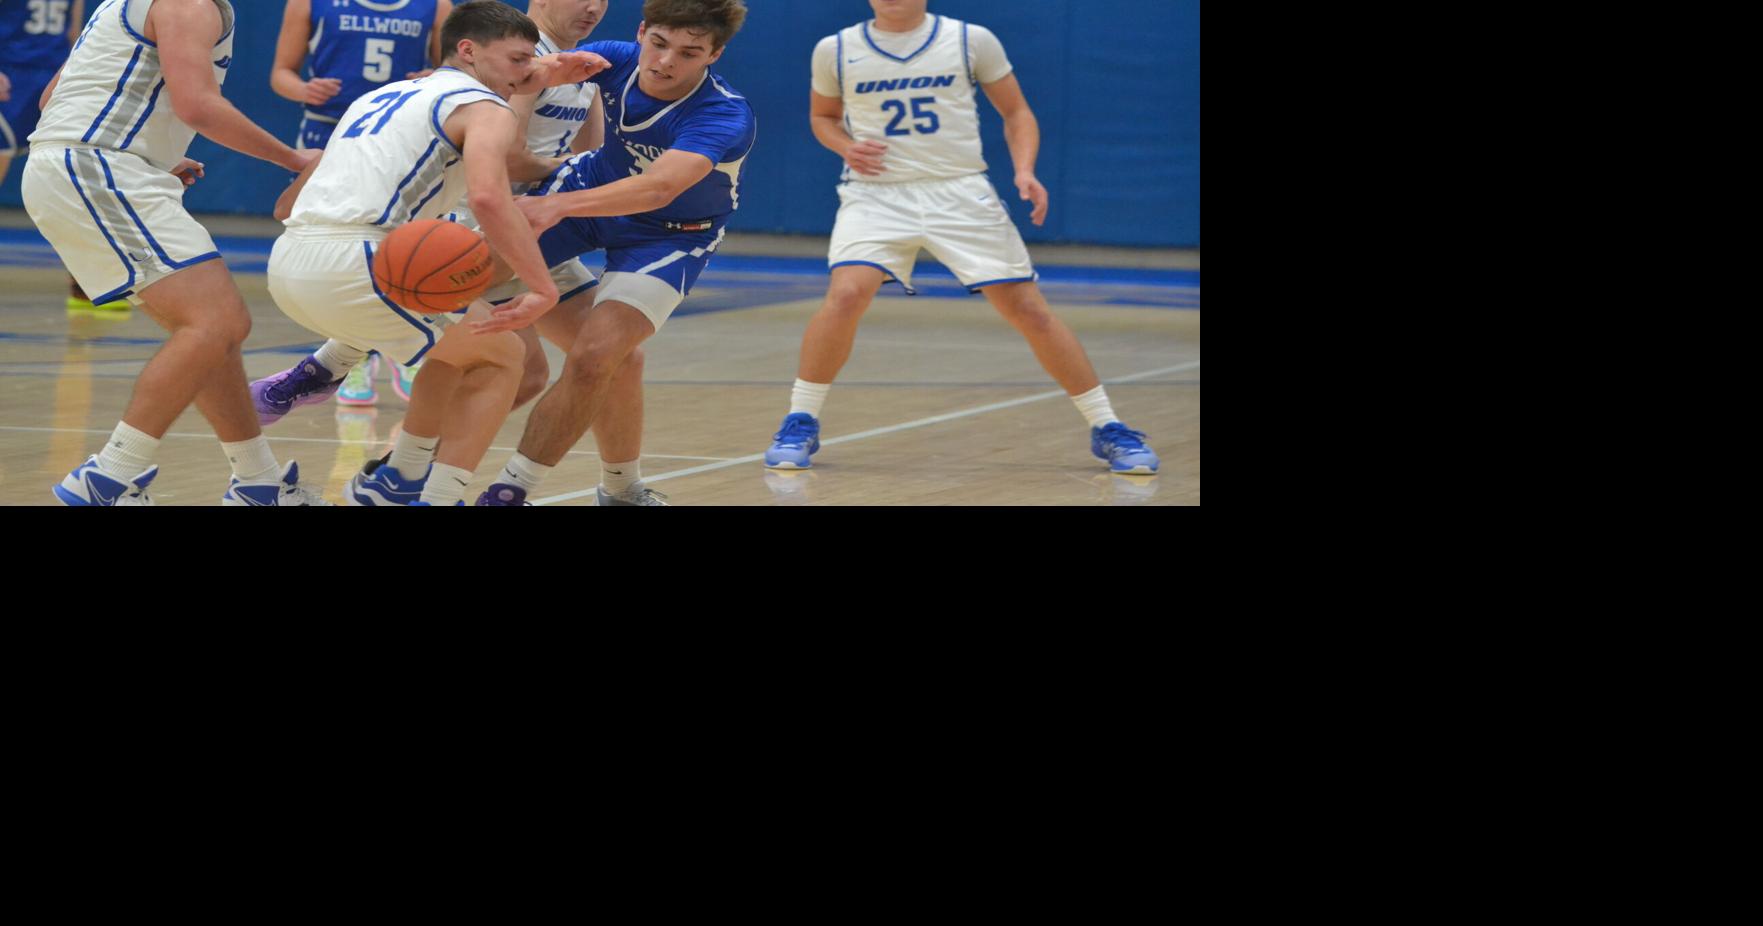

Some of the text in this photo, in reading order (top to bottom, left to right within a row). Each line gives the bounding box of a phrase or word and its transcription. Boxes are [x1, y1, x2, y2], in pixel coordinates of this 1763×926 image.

[25, 0, 68, 35] 35
[339, 14, 423, 38] ELLWOOD
[362, 37, 395, 83] 5
[855, 74, 956, 94] UNION
[341, 89, 423, 138] 21
[880, 96, 940, 137] 25
